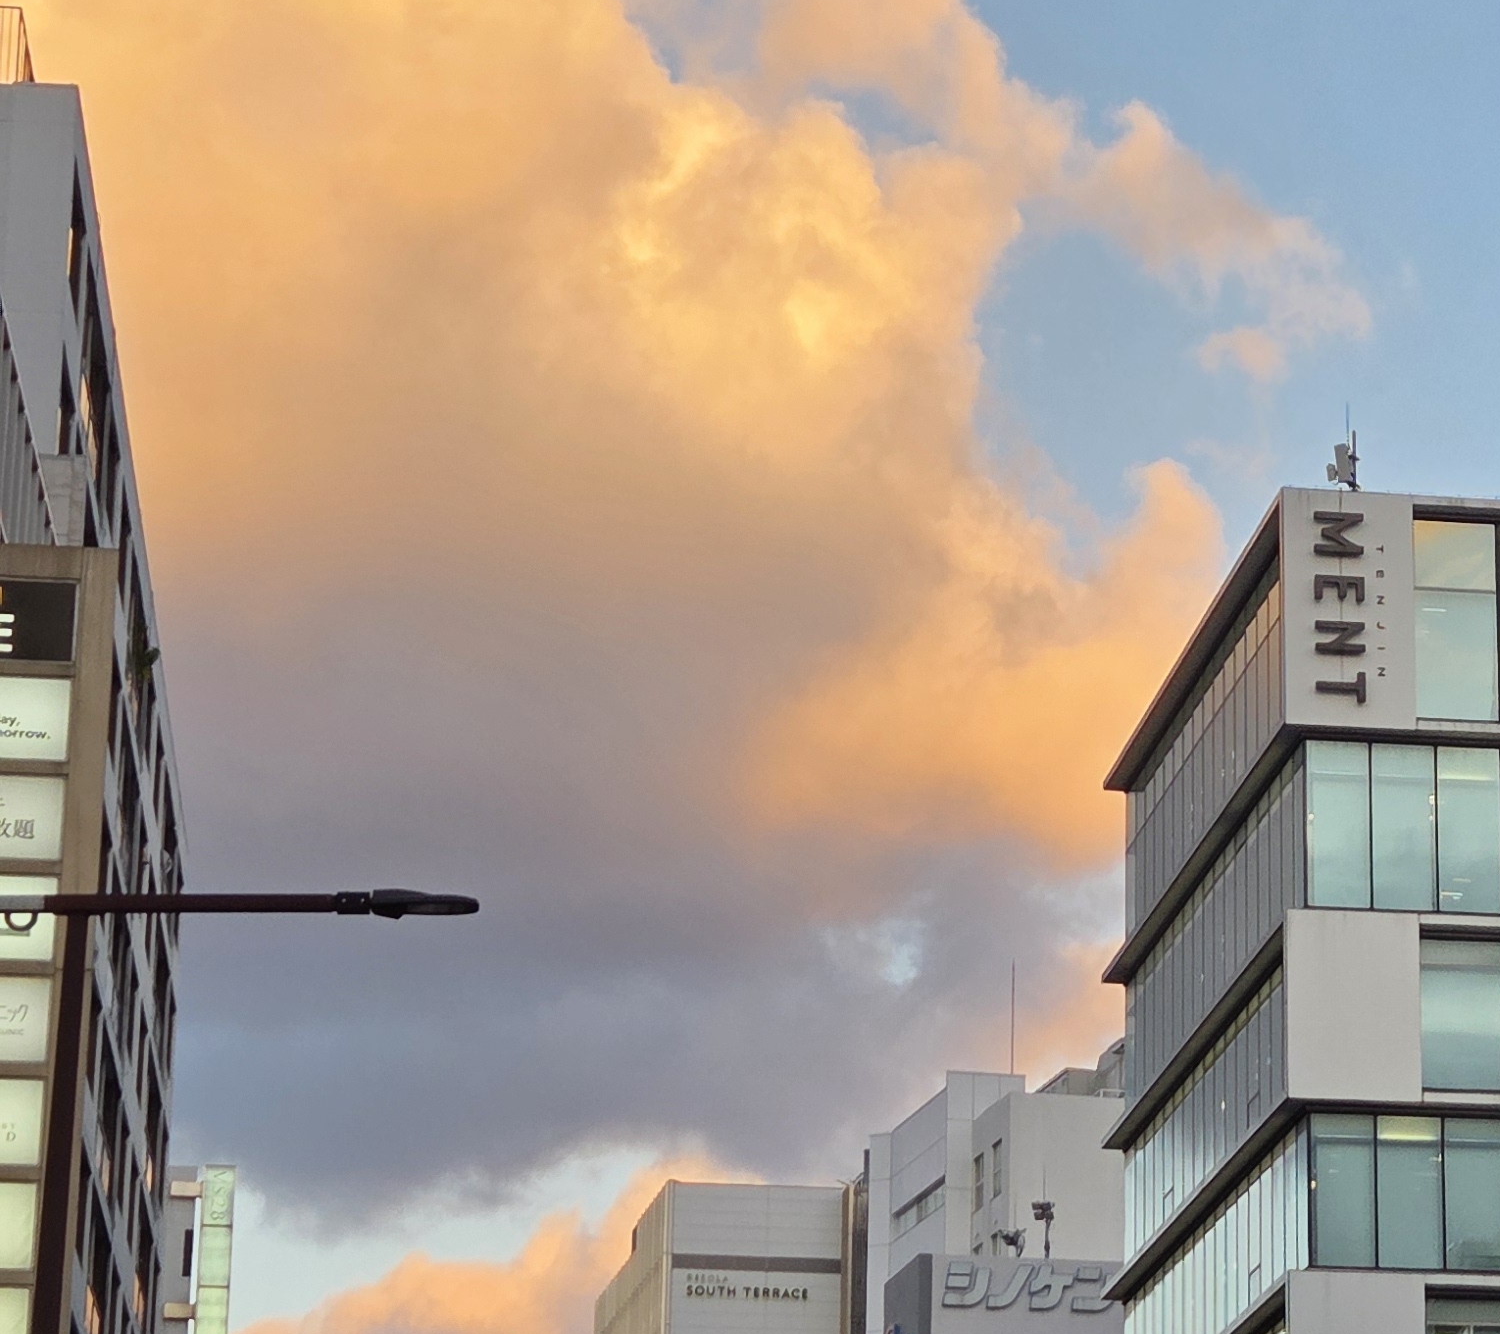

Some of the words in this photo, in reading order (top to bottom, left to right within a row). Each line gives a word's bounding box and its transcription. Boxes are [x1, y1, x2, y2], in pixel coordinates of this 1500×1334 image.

[1313, 510, 1366, 704] MENT
[1375, 544, 1386, 677] TENJIN
[686, 1284, 736, 1298] SOUTH
[743, 1286, 809, 1300] TERRACE
[941, 1261, 1119, 1313] シノケン
